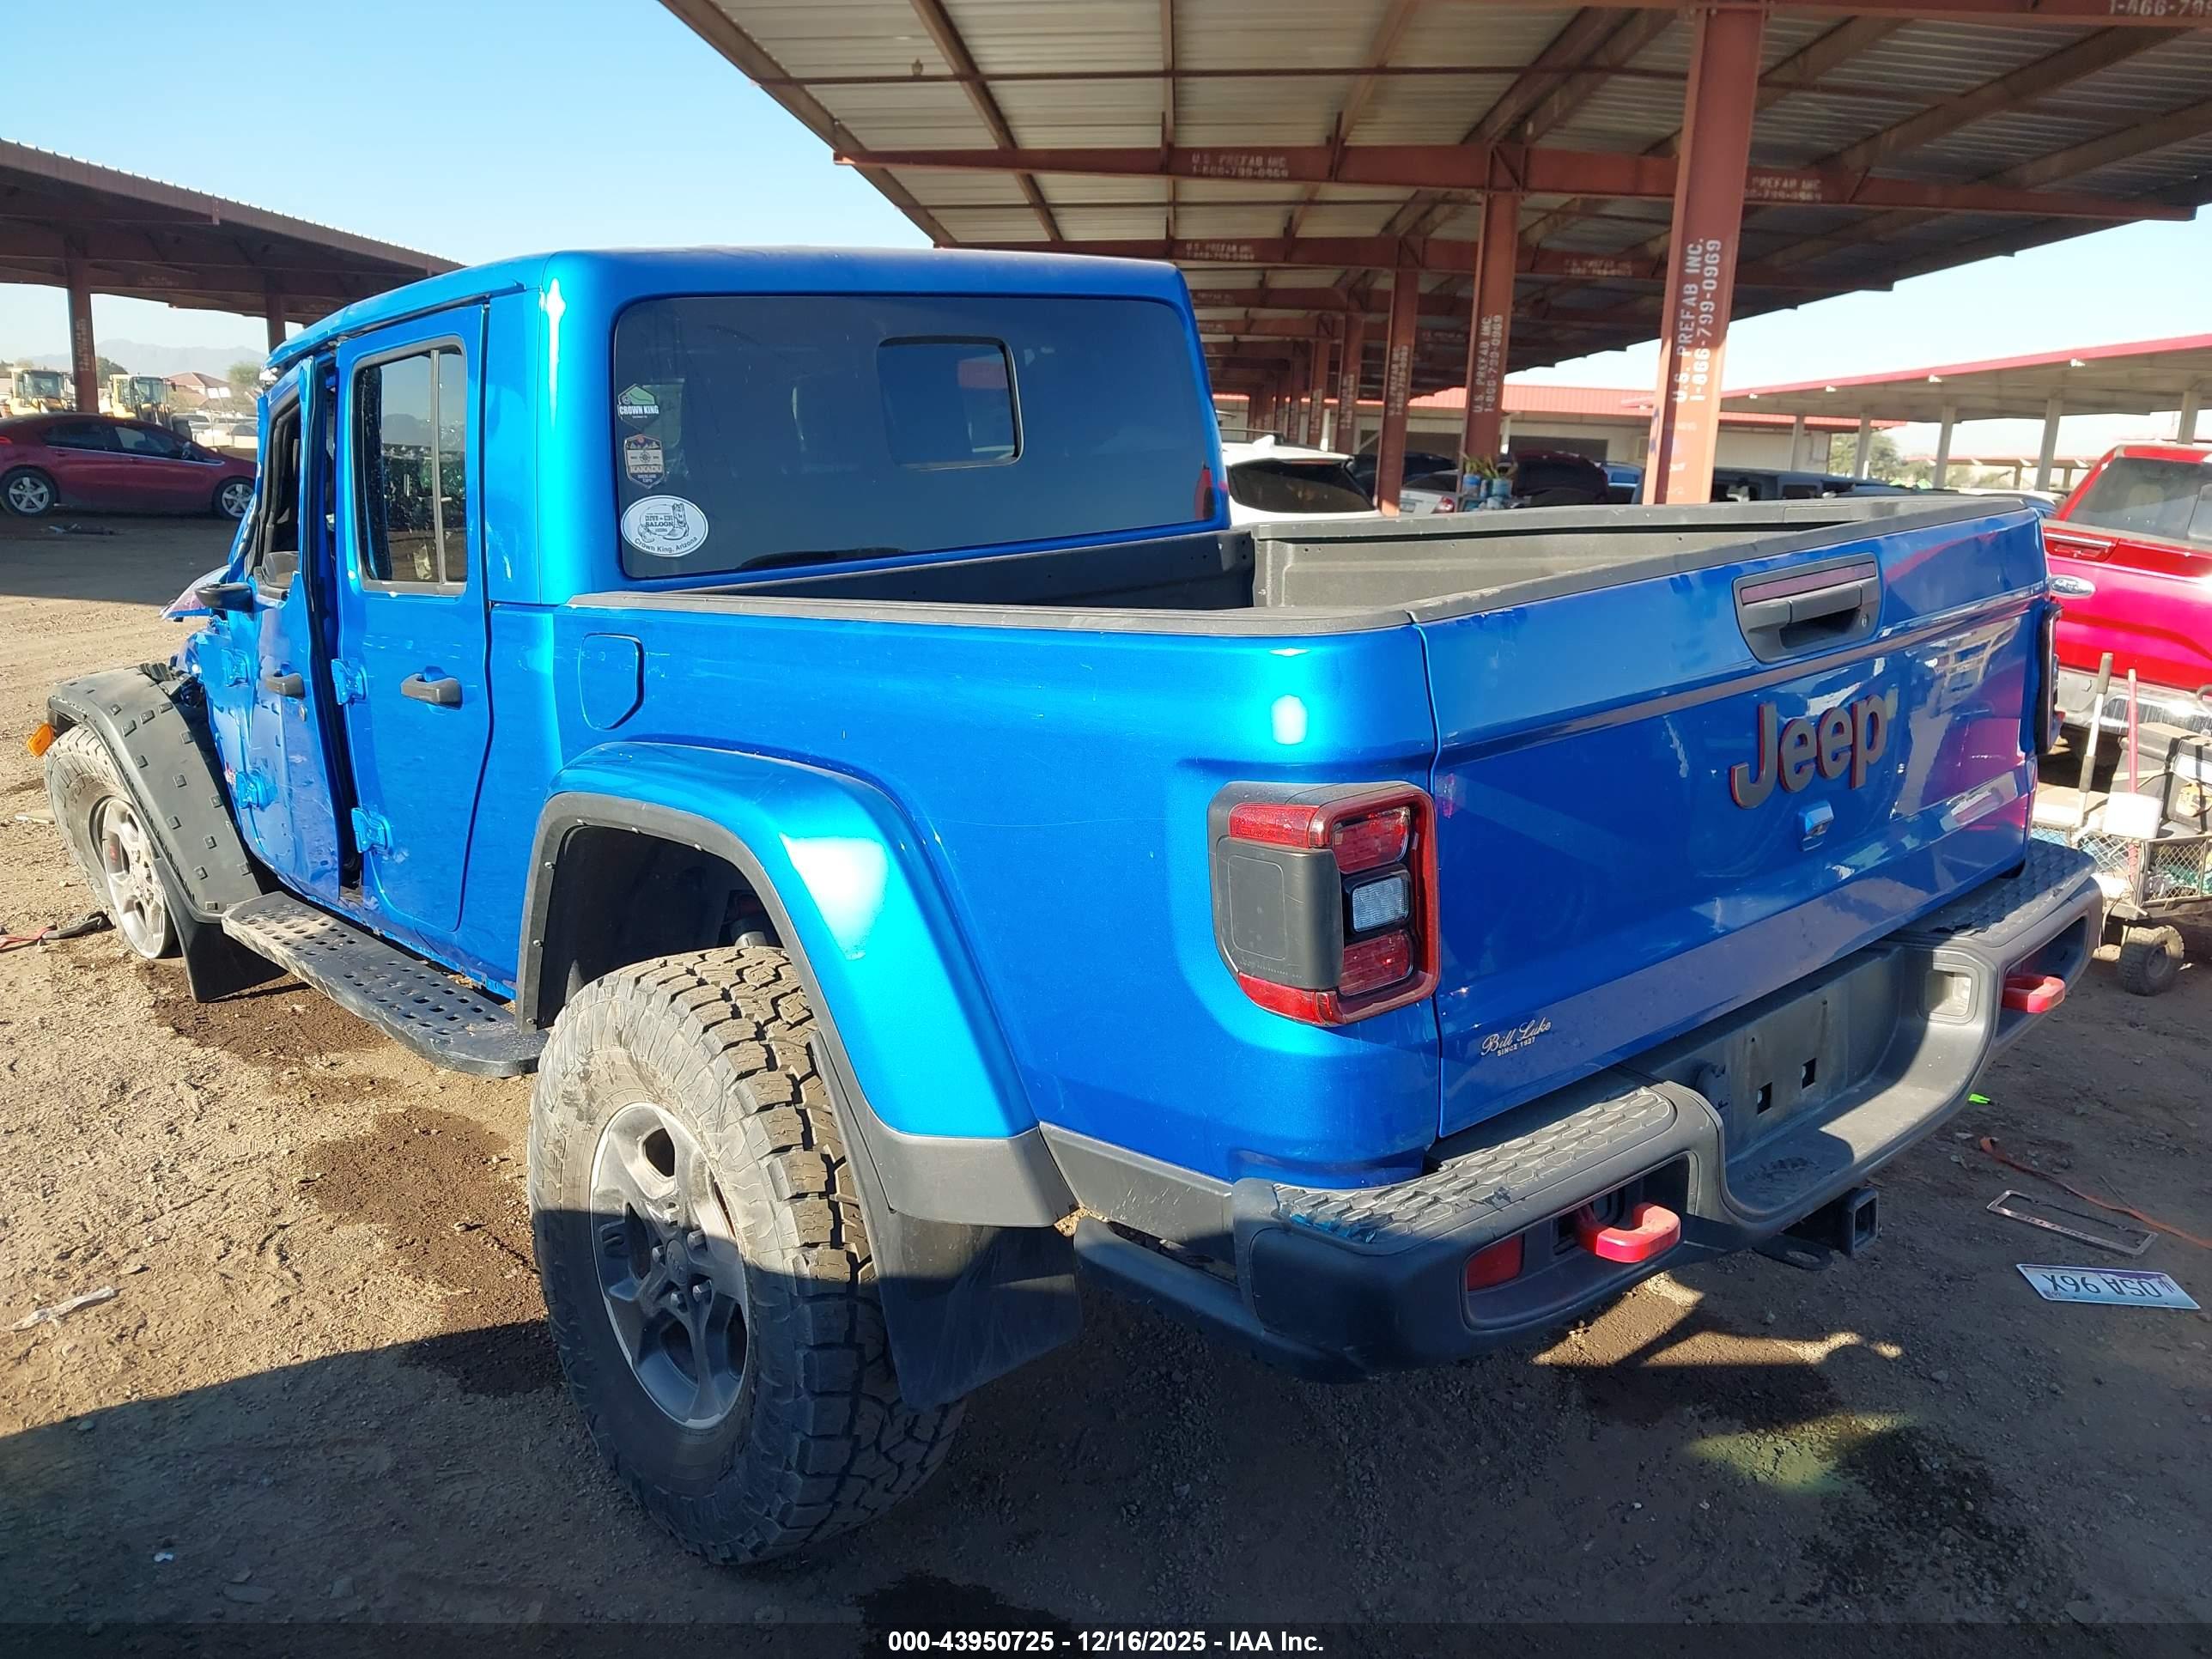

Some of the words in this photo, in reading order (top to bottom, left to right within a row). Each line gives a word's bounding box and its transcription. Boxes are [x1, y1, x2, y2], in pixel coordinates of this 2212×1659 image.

[1685, 238, 1704, 274] INC.
[1677, 283, 1699, 357] PREFAB
[1689, 240, 1722, 402] 1-866-799-0969
[1672, 366, 1691, 404] U.S.
[619, 404, 643, 415] CROWN
[643, 404, 659, 415] KING
[635, 538, 655, 551] Crown
[676, 536, 698, 550] Arizona
[1730, 694, 1889, 810] Jeep
[1480, 1028, 1516, 1056] Bill
[1516, 1017, 1553, 1042] Luke
[1497, 1043, 1518, 1057] SINCE
